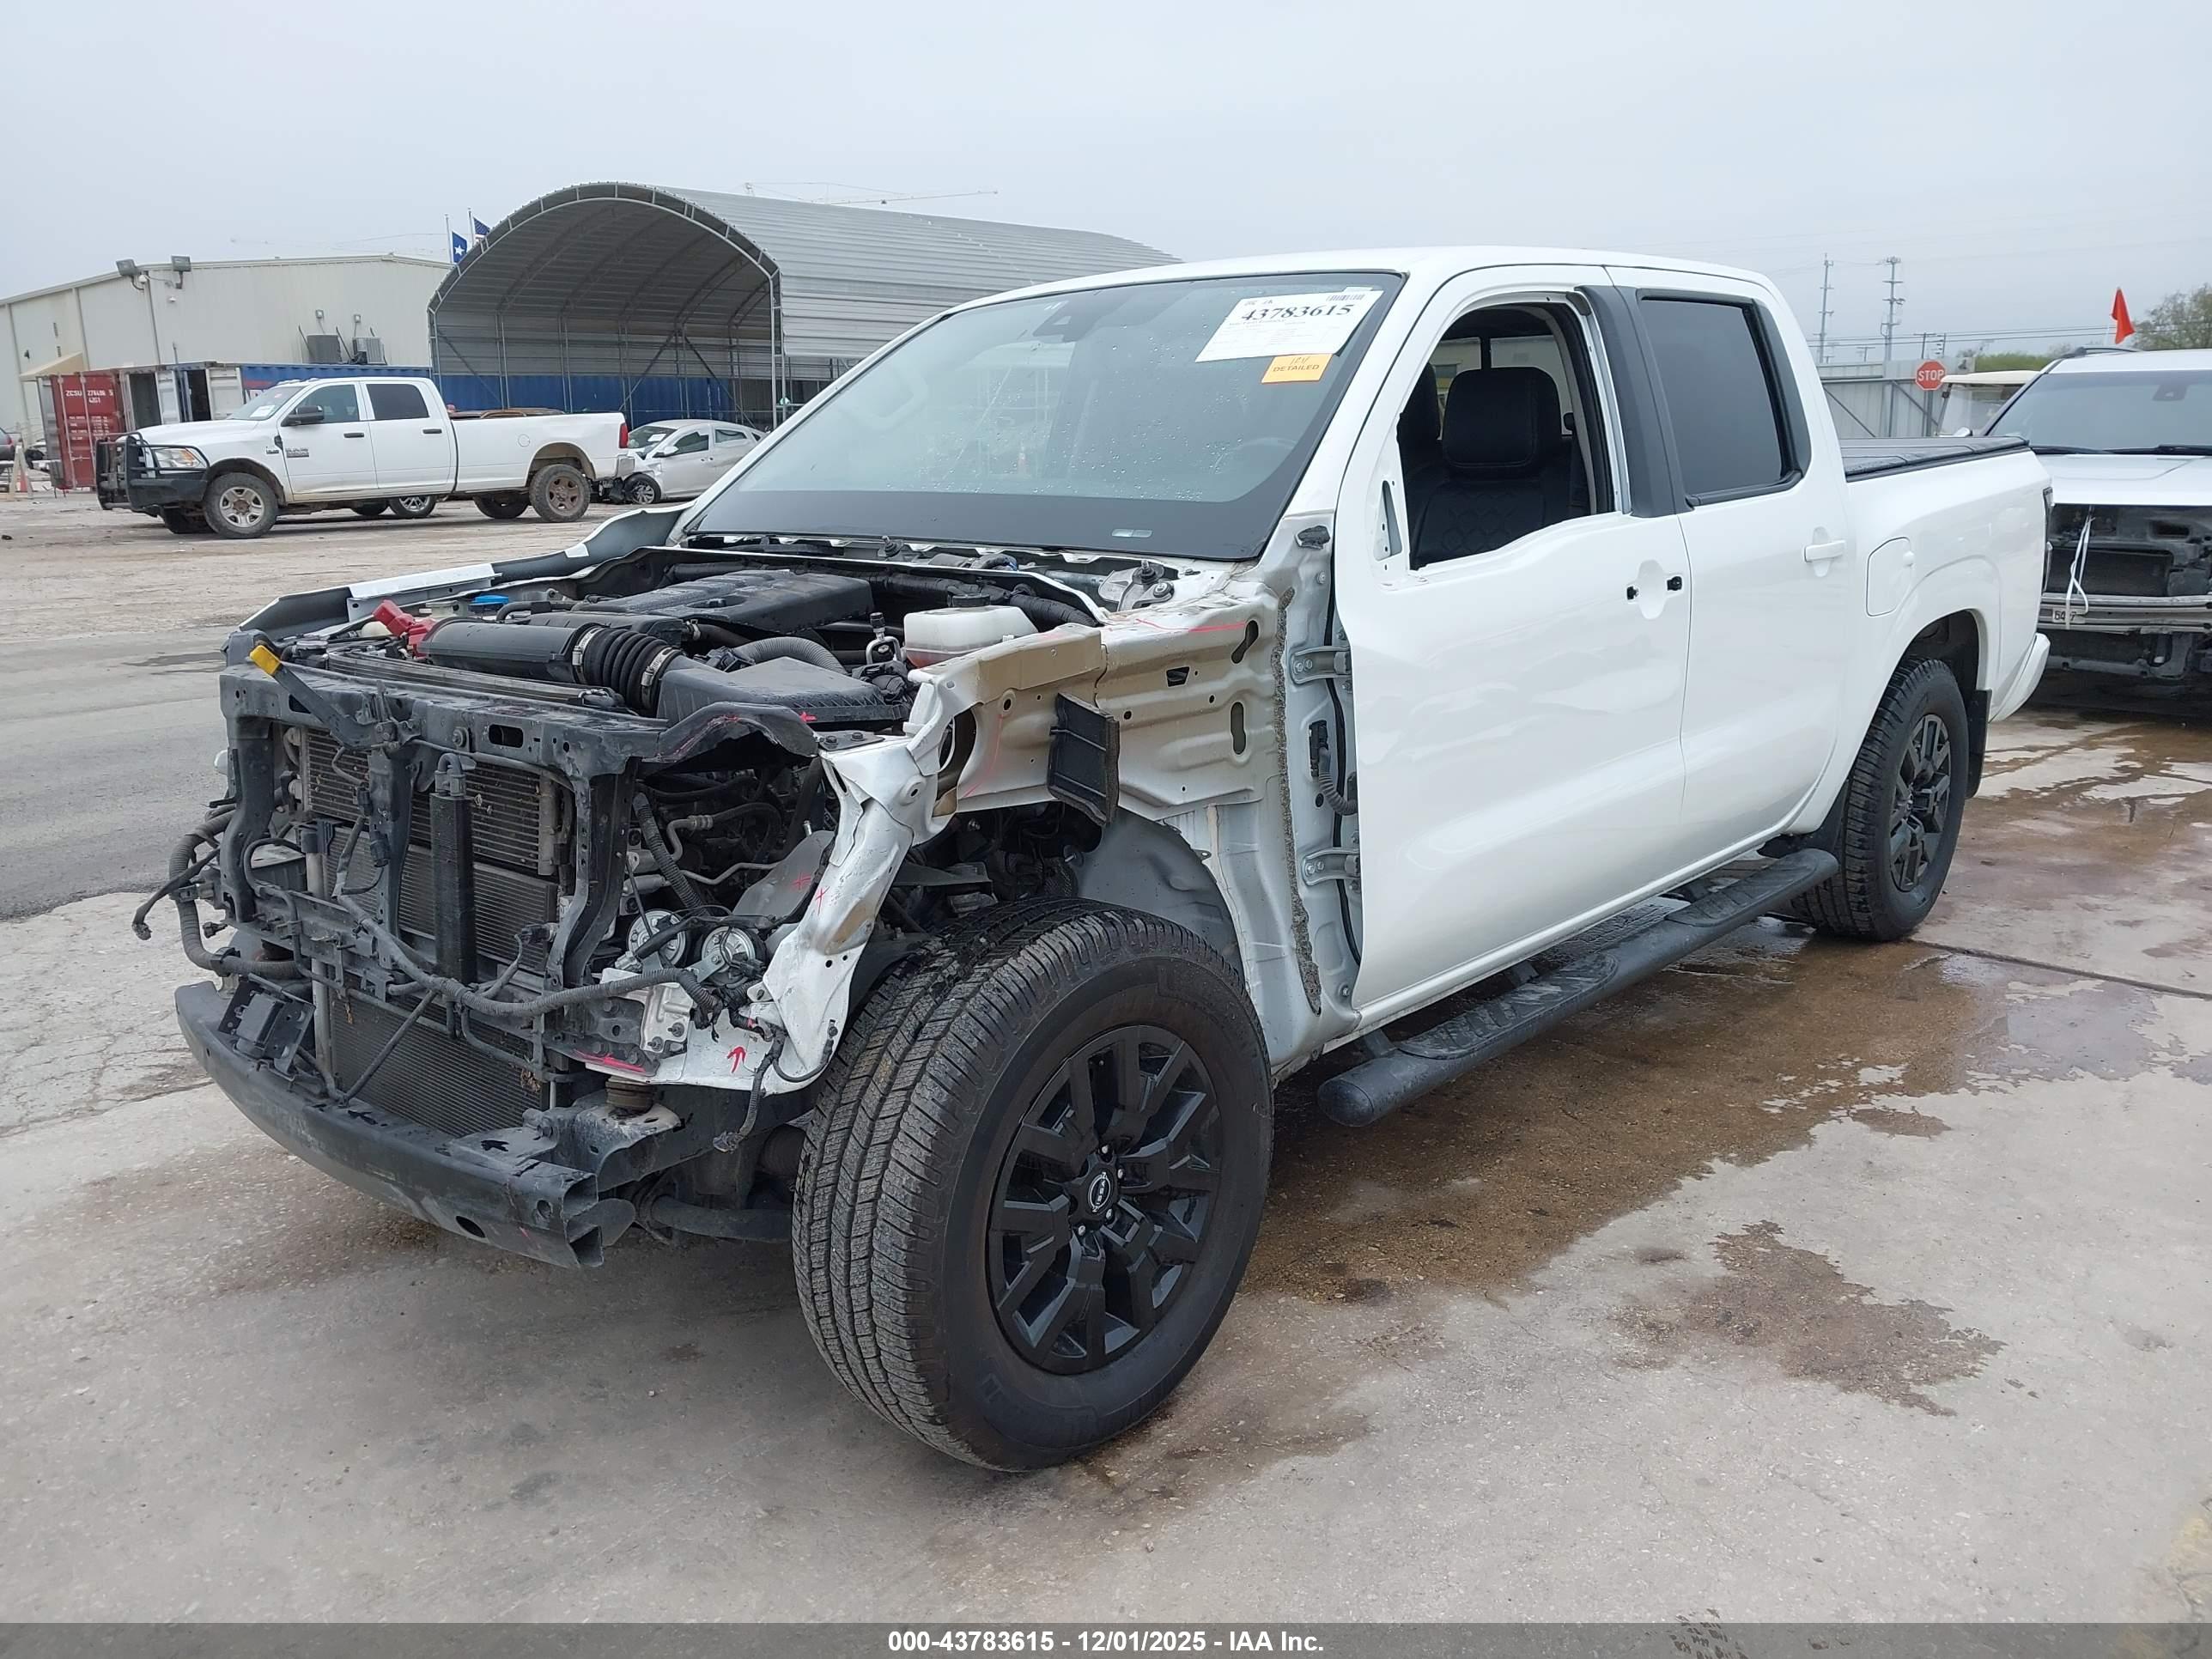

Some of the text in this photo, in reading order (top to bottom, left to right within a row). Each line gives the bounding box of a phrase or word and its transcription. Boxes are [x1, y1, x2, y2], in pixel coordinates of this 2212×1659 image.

[1242, 304, 1353, 321] 43783615
[1273, 363, 1320, 373] DETAILED
[1917, 369, 1944, 381] STOP
[2054, 610, 2077, 621] 647
